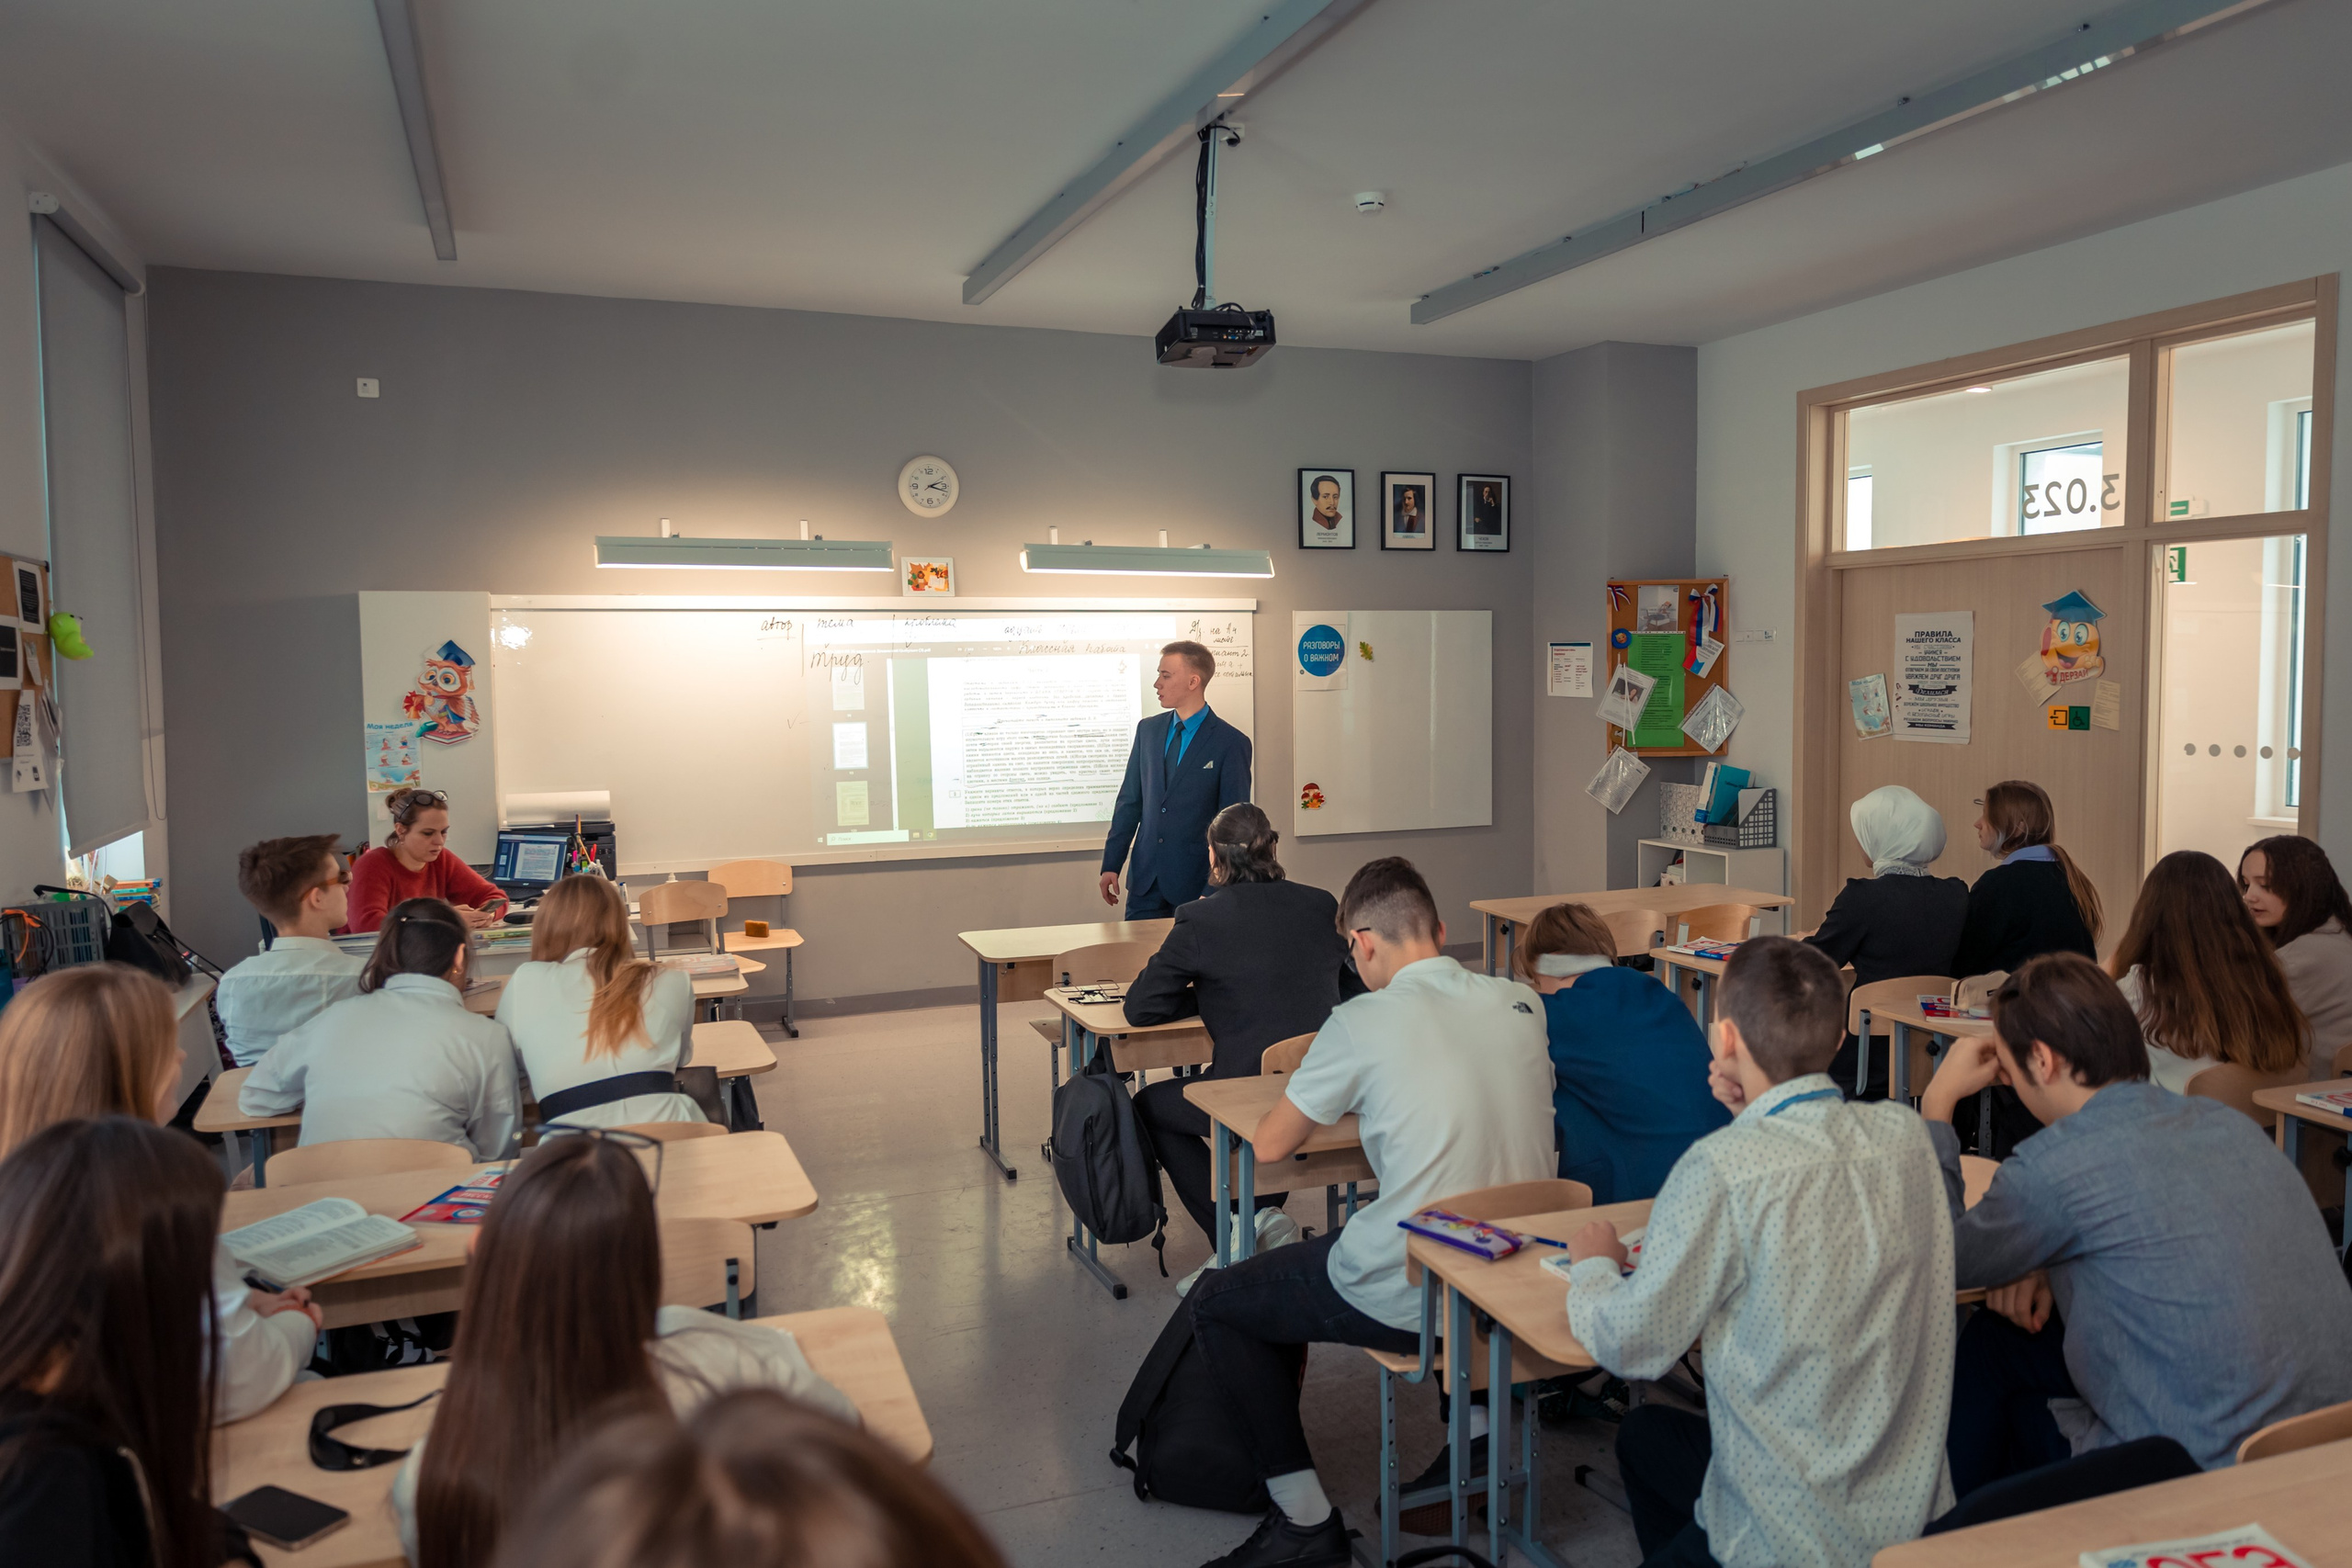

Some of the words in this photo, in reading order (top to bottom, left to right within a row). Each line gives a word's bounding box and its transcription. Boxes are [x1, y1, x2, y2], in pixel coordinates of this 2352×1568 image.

[1303, 641, 1340, 650] РАЗГОВОРЫ
[1304, 654, 1308, 662] О
[1310, 653, 1339, 662] ВАЖНОМ
